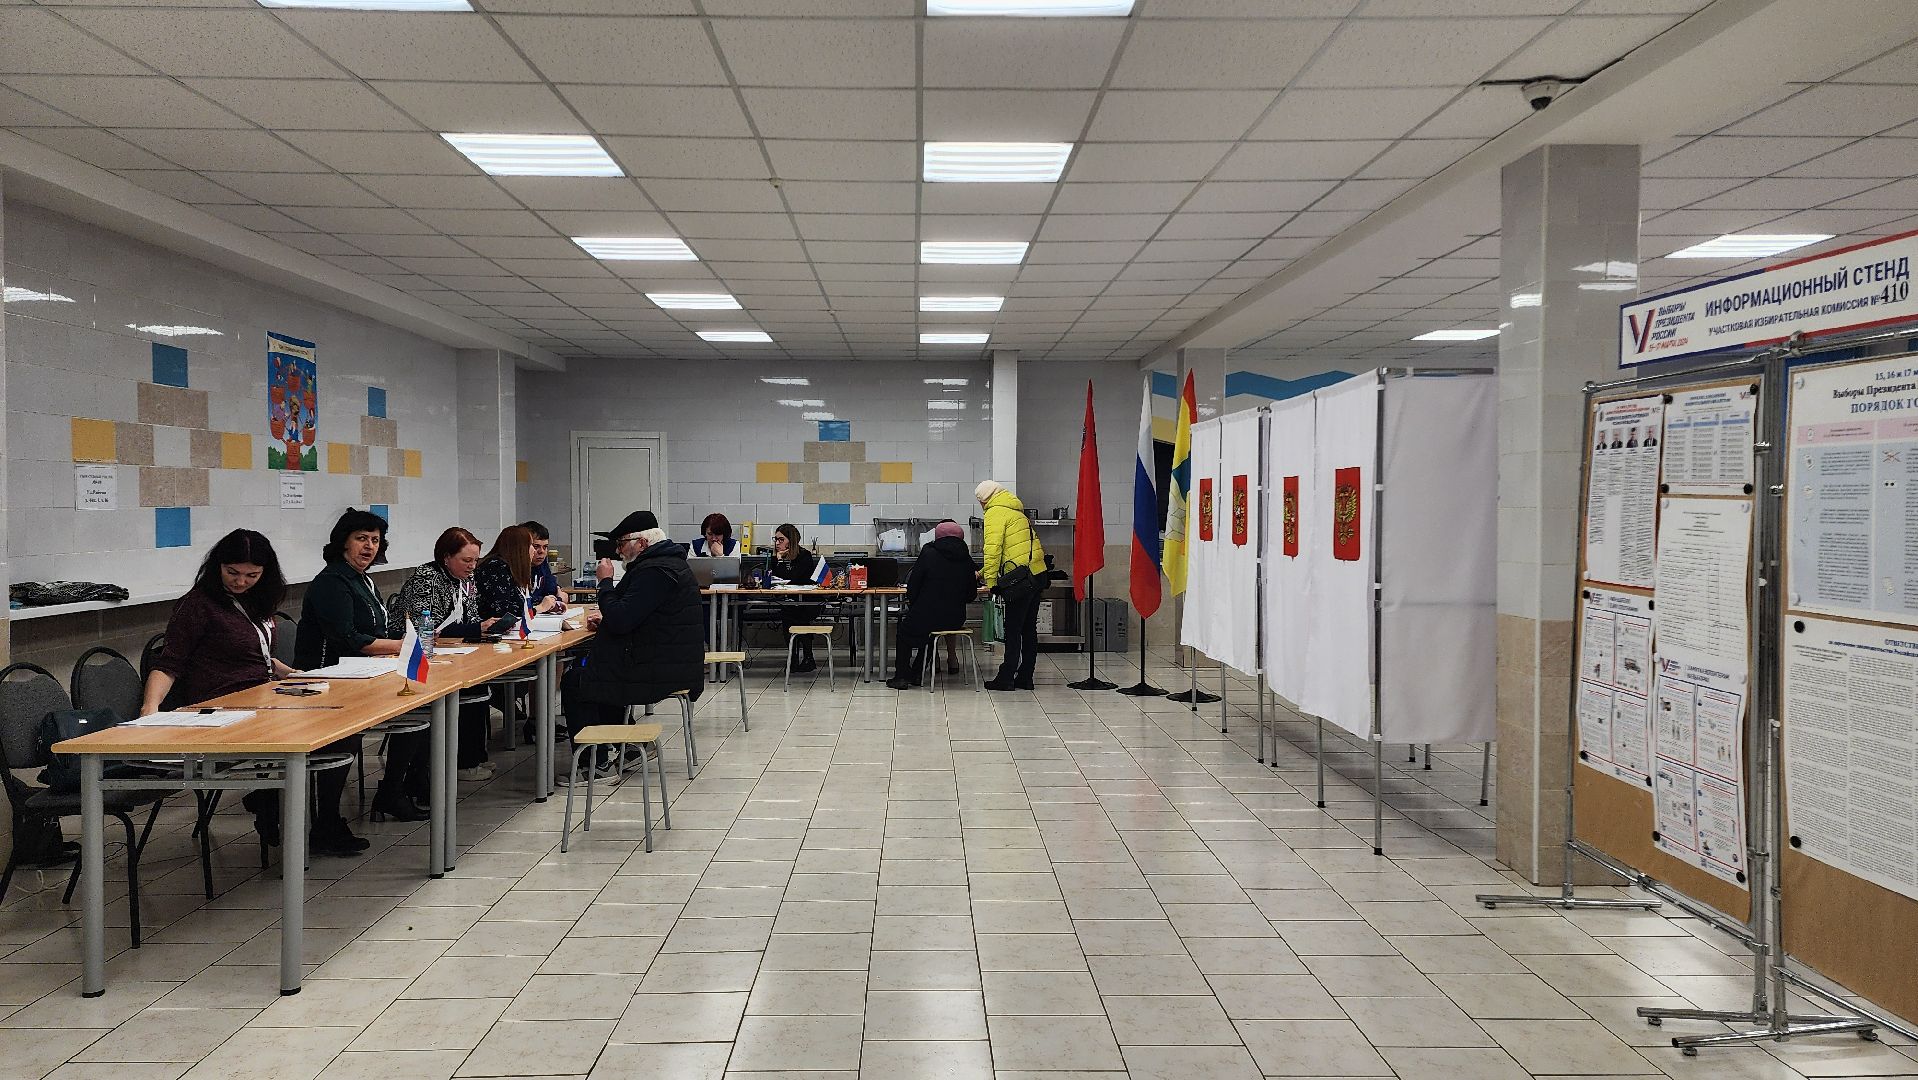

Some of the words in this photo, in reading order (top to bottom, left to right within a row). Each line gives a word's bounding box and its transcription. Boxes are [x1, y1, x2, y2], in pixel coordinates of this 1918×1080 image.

[1705, 265, 1848, 317] ИНФОРМАЦИОННЫЙ
[1853, 256, 1909, 286] СТЕНД
[1658, 301, 1686, 317] ВЫБОРЫ
[1708, 319, 1754, 337] УЧАСТКОВАЯ
[1754, 306, 1820, 328] ИЗБИРАТЕЛЬНАЯ
[1821, 297, 1869, 318] КОМИССИЯ
[1655, 312, 1695, 328] ПРЕЗИДЕНТА
[1651, 328, 1677, 341] РОССИИ
[1904, 368, 1912, 377] 17
[1832, 387, 1865, 399] Выборы
[1866, 382, 1916, 397] Президента
[1851, 399, 1904, 413] ПОРЯДОК
